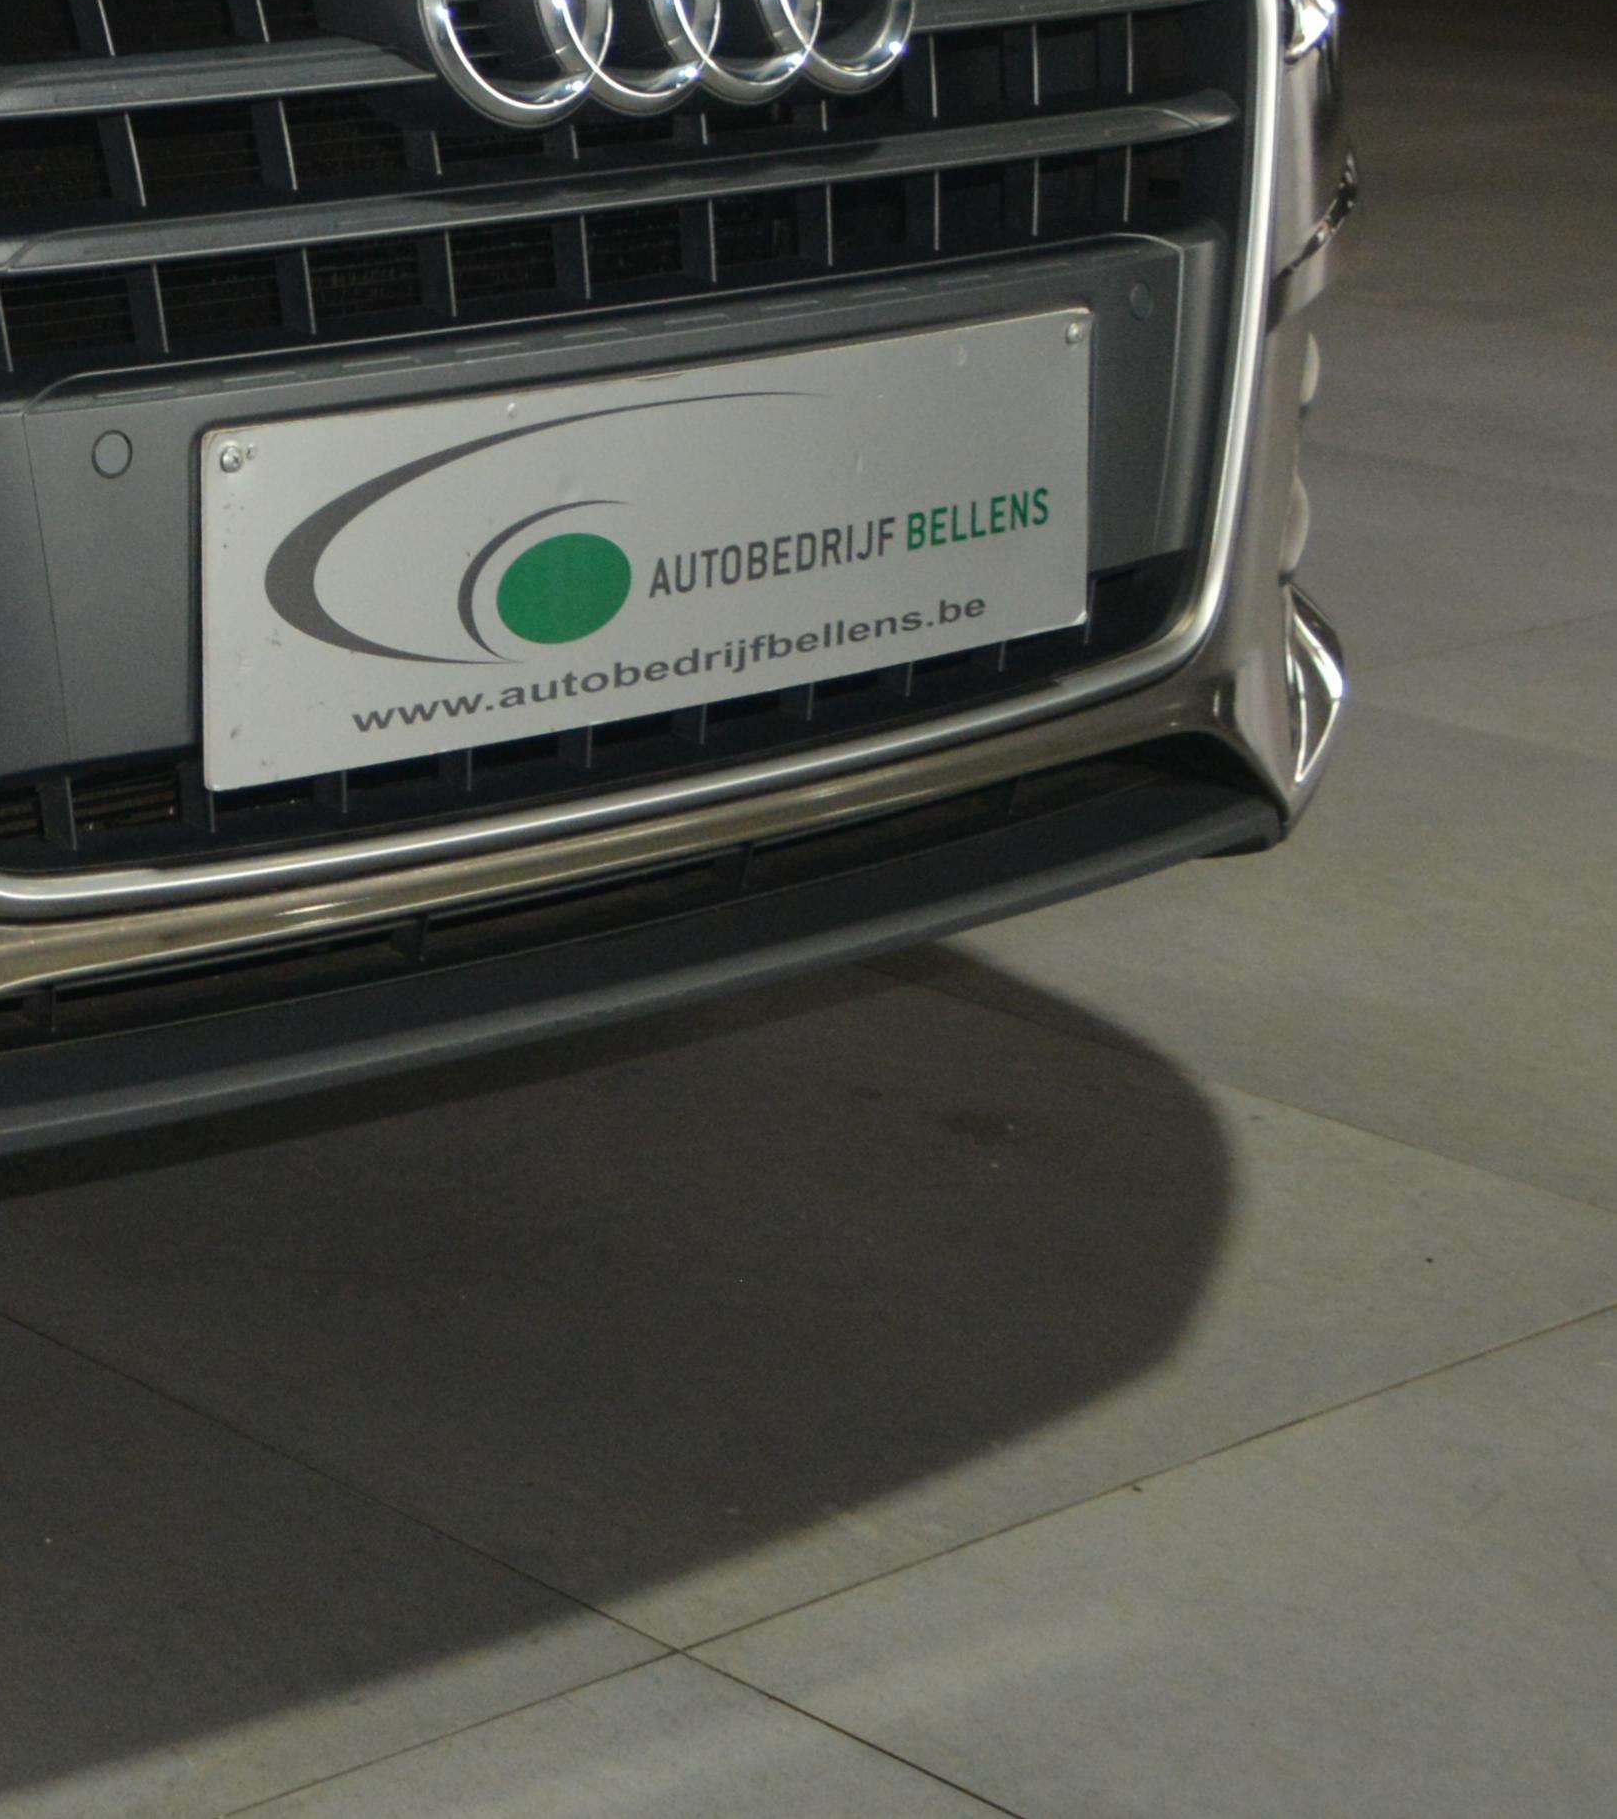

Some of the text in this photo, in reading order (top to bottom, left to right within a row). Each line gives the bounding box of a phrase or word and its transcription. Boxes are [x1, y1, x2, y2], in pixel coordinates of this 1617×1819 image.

[649, 486, 1050, 599] AUTOBEDRIJF BELLENS
[351, 594, 988, 735] www.autobedrijfbellens.be
